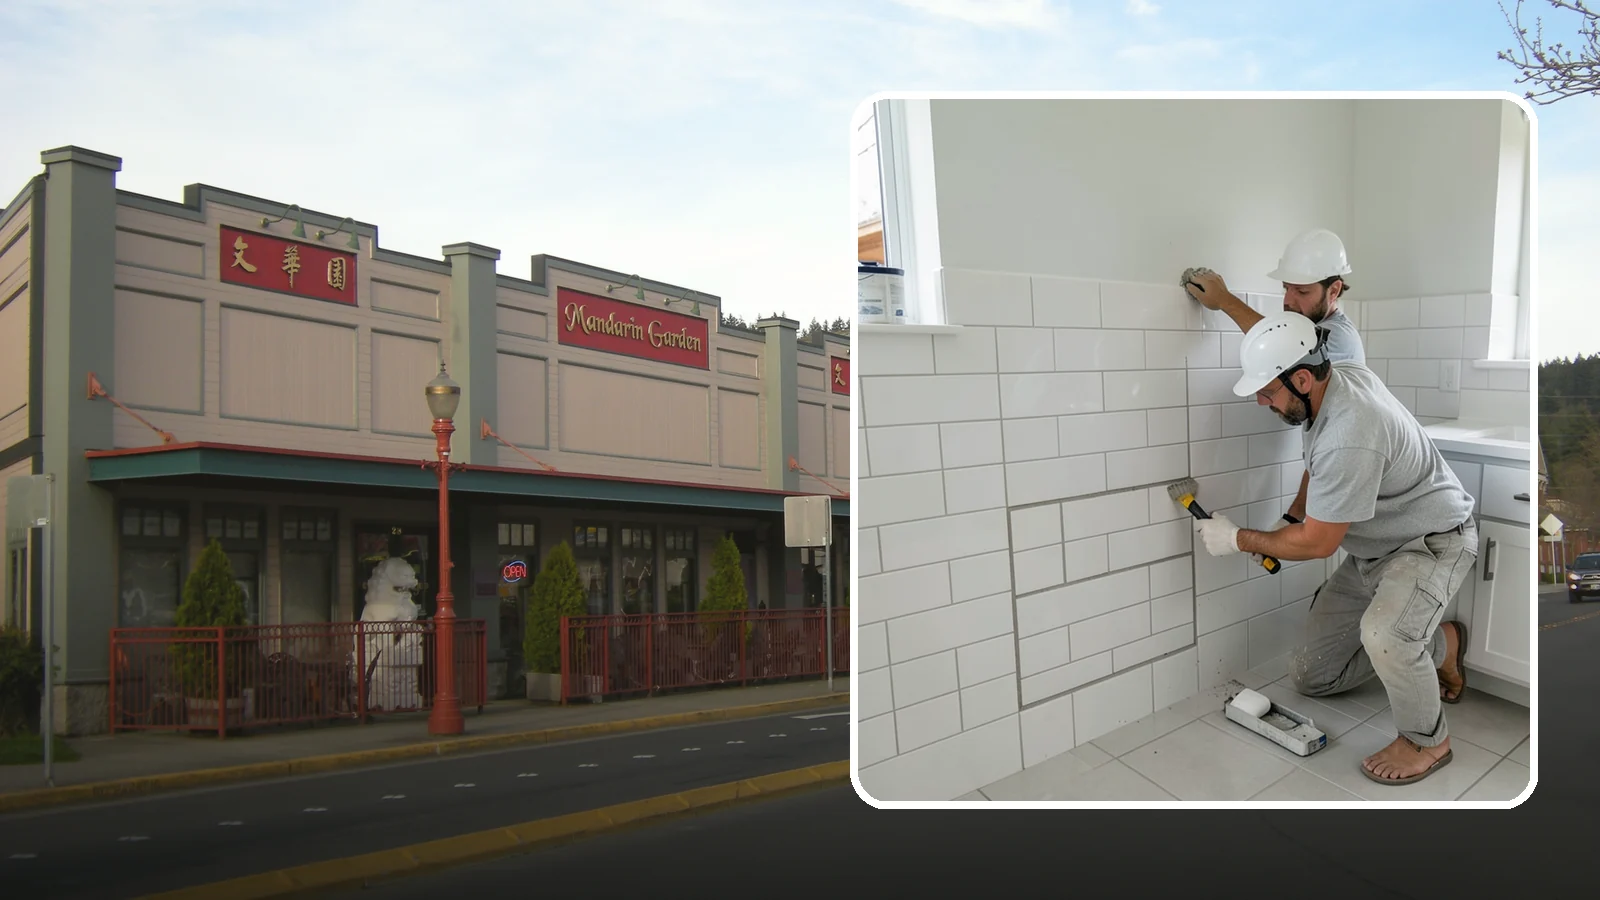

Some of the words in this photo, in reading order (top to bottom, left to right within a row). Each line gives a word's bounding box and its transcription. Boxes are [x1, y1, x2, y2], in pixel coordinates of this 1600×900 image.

[230, 236, 346, 291] 文華園
[564, 302, 644, 341] Mandarin
[648, 320, 702, 352] Garden
[504, 566, 526, 578] OPEN
